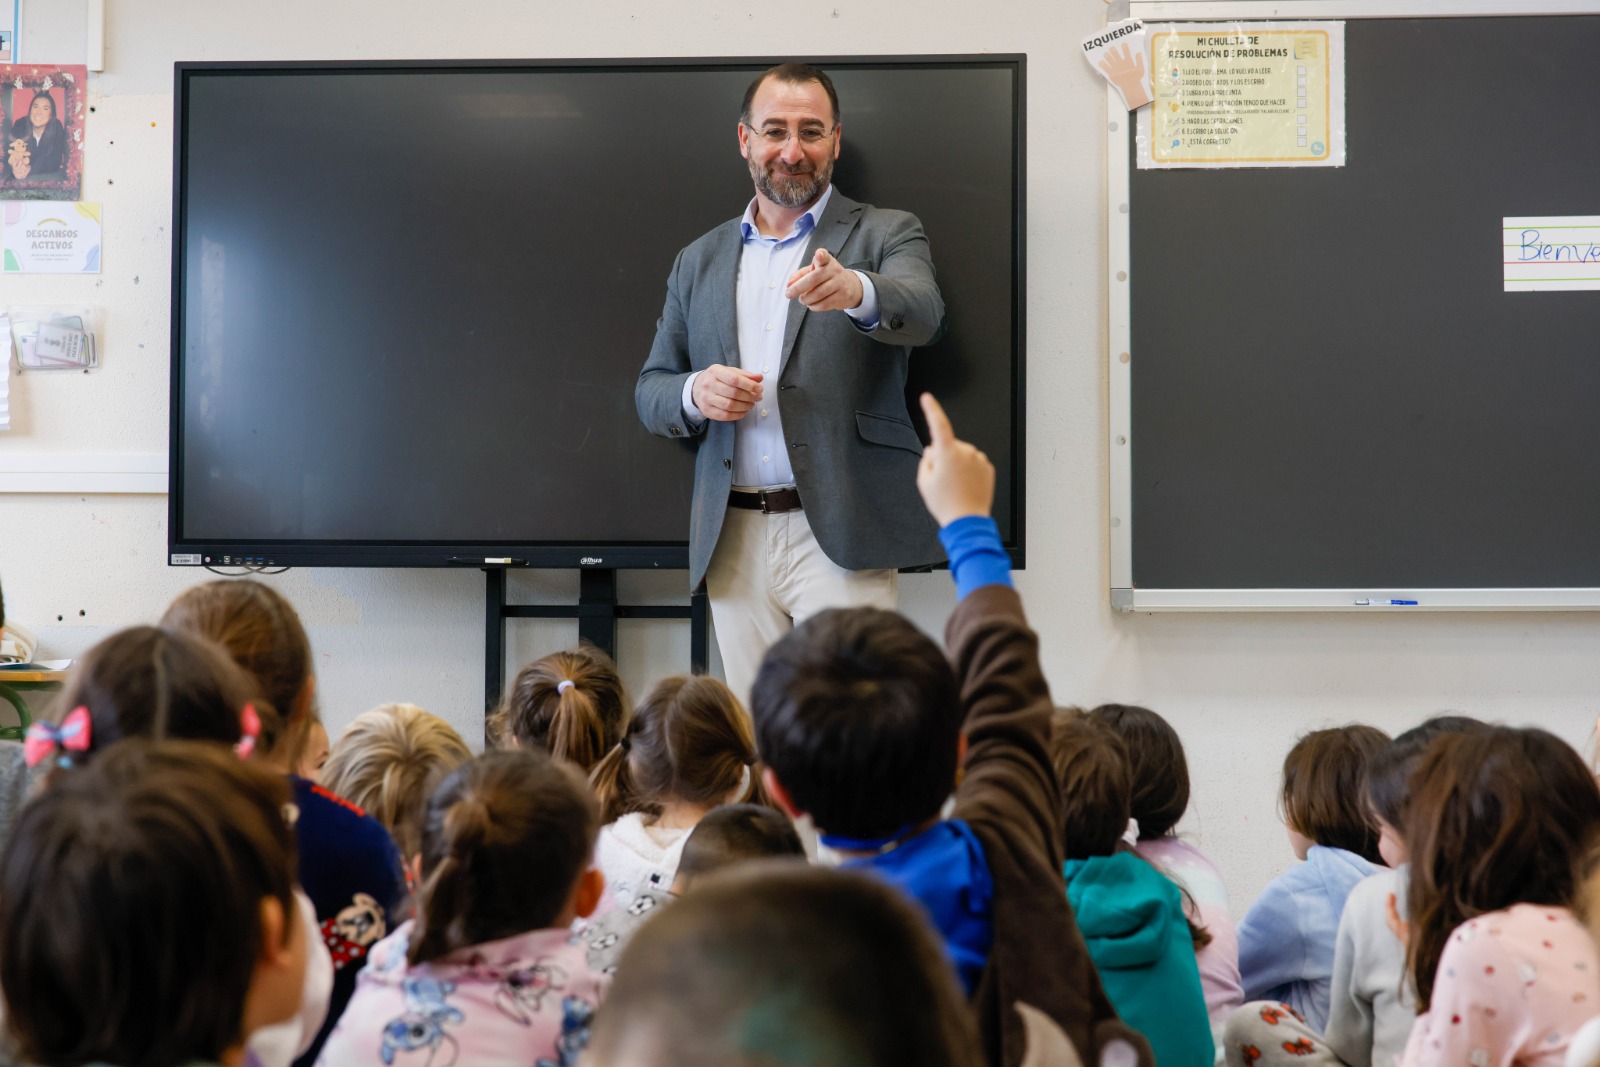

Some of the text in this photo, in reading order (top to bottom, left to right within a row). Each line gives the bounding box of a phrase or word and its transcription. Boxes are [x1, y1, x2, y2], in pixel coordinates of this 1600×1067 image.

[1083, 22, 1142, 52] IZQUIERDA
[1197, 37, 1206, 46] MI
[1247, 36, 1259, 45] DE
[1168, 48, 1221, 59] RESOLUCIÓN
[1237, 48, 1288, 58] PROBLEMAS
[26, 230, 78, 238] DESCANSOS
[31, 241, 74, 250] ACTIVOS
[1518, 229, 1600, 263] Bienve
